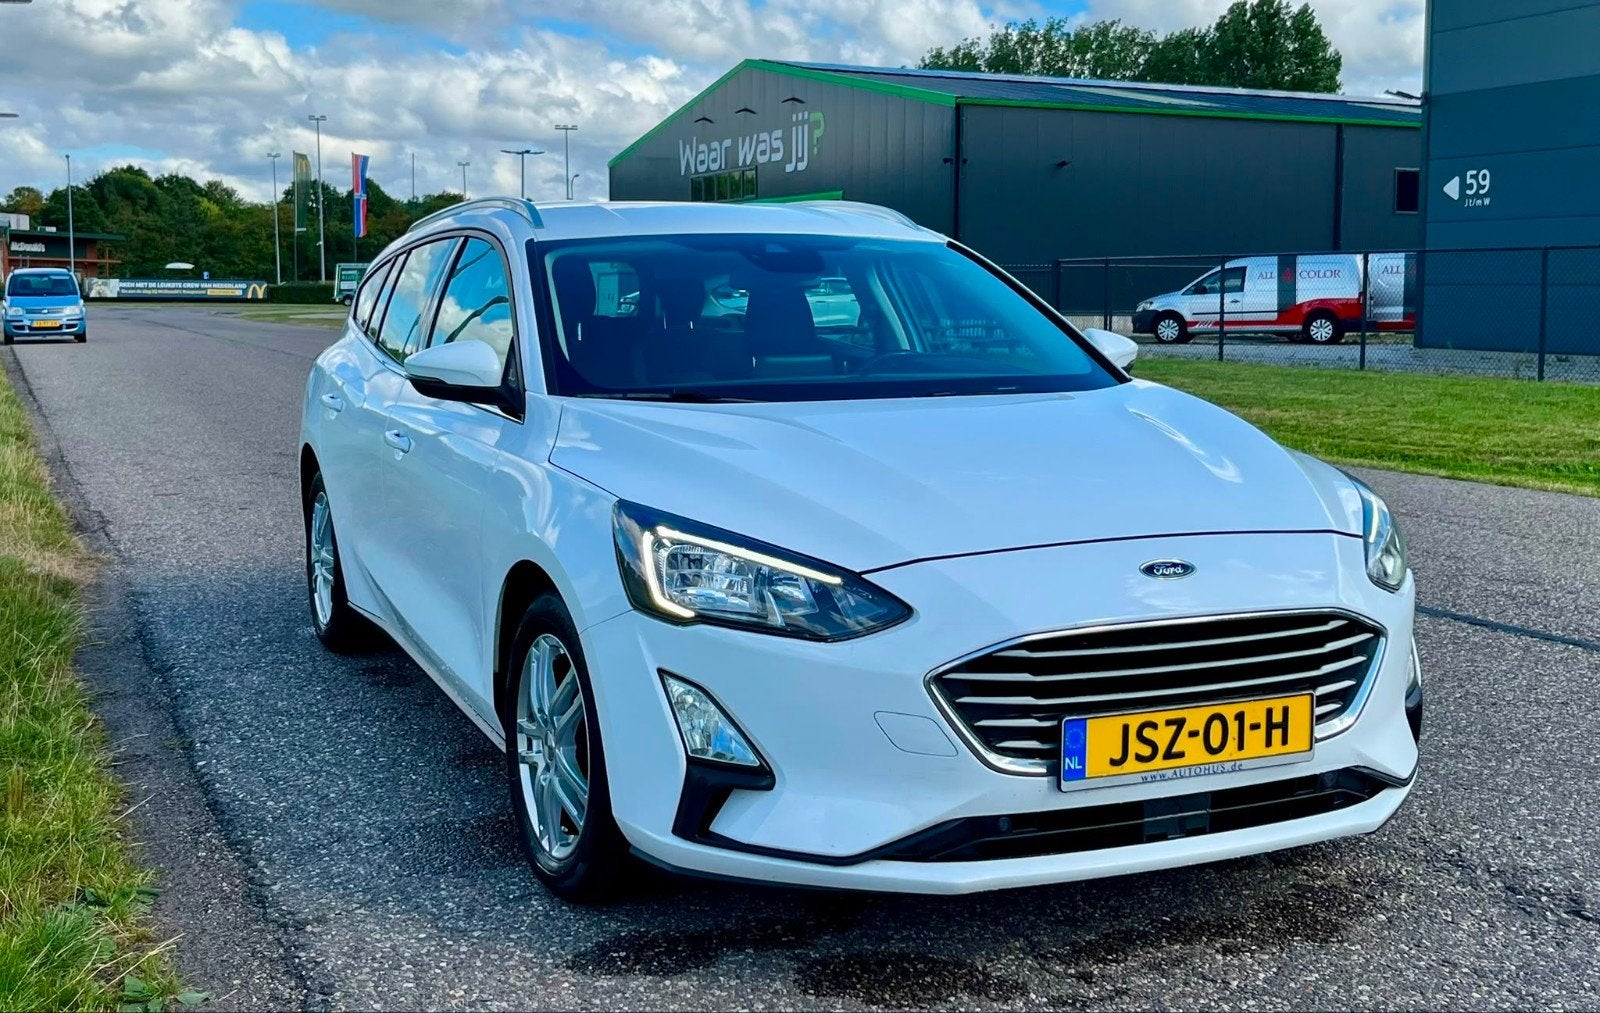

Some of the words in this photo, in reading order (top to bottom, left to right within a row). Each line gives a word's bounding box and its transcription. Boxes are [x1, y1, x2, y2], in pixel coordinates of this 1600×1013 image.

[679, 136, 732, 176] Waar
[737, 128, 784, 167] was
[785, 111, 826, 173] jij?
[1465, 169, 1490, 195] 59
[1257, 271, 1276, 280] ALL
[1299, 269, 1341, 279] COLOR
[1381, 265, 1403, 275] ALL
[1153, 562, 1184, 575] Ford
[1109, 705, 1290, 767] JSZ-01-H
[1065, 756, 1083, 771] NL
[1140, 761, 1243, 783] www.AUTOHUS.de
